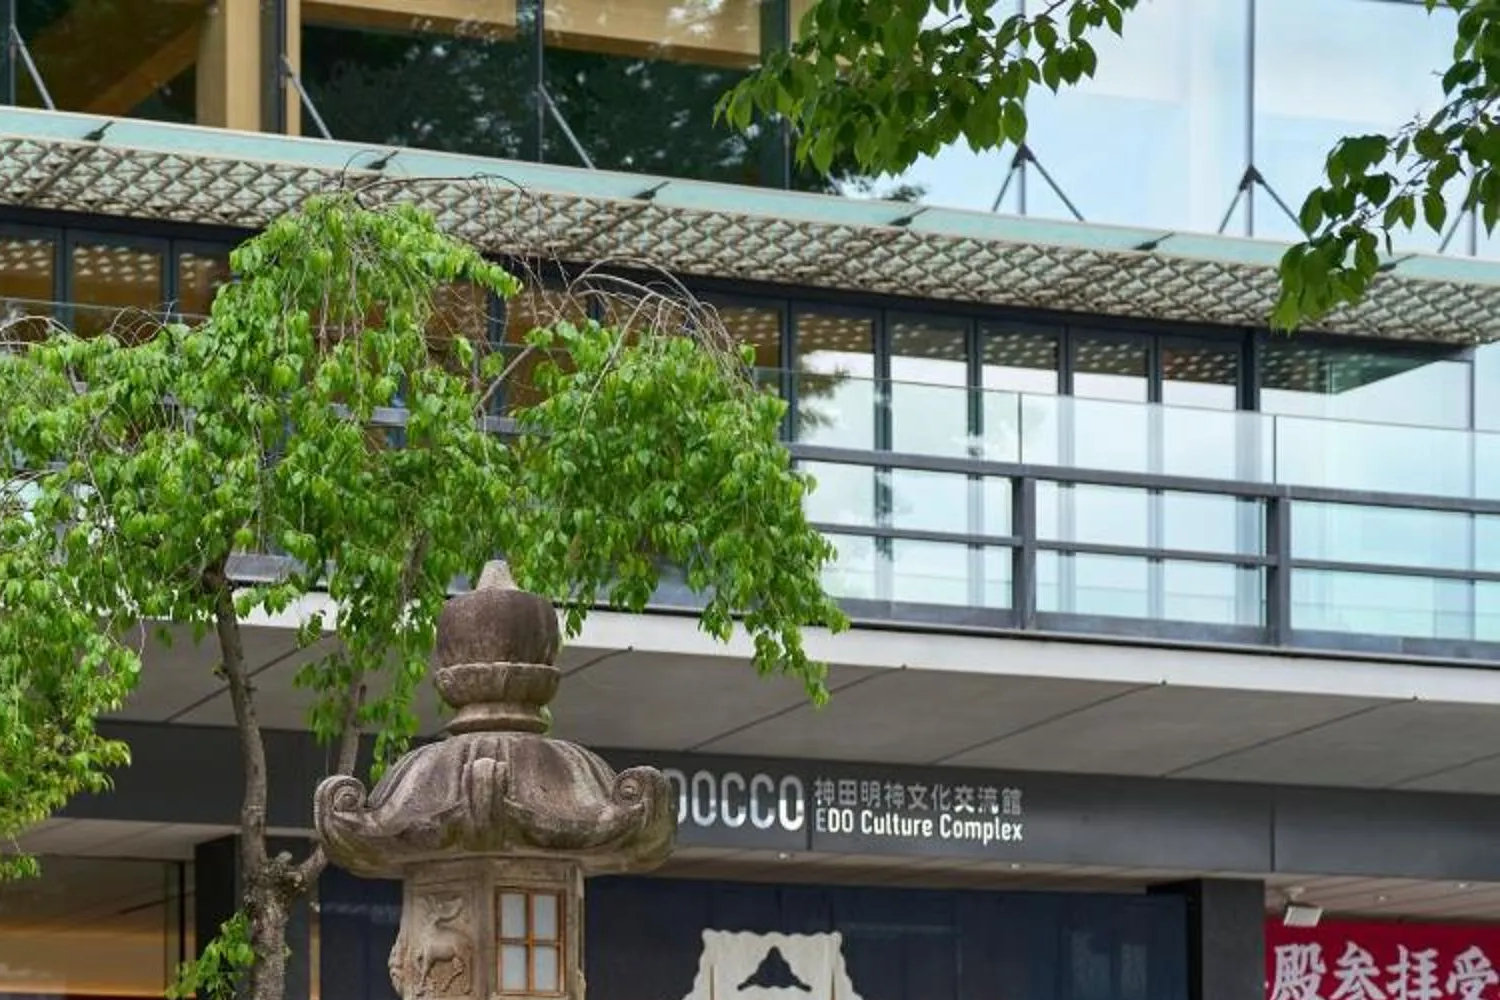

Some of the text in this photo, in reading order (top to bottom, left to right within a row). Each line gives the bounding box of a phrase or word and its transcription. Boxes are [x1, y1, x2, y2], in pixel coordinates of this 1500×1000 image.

[663, 768, 805, 832] DOCCO
[813, 779, 1023, 816] 神田明神文化交流館
[816, 809, 1024, 846] EDO Culture Complex
